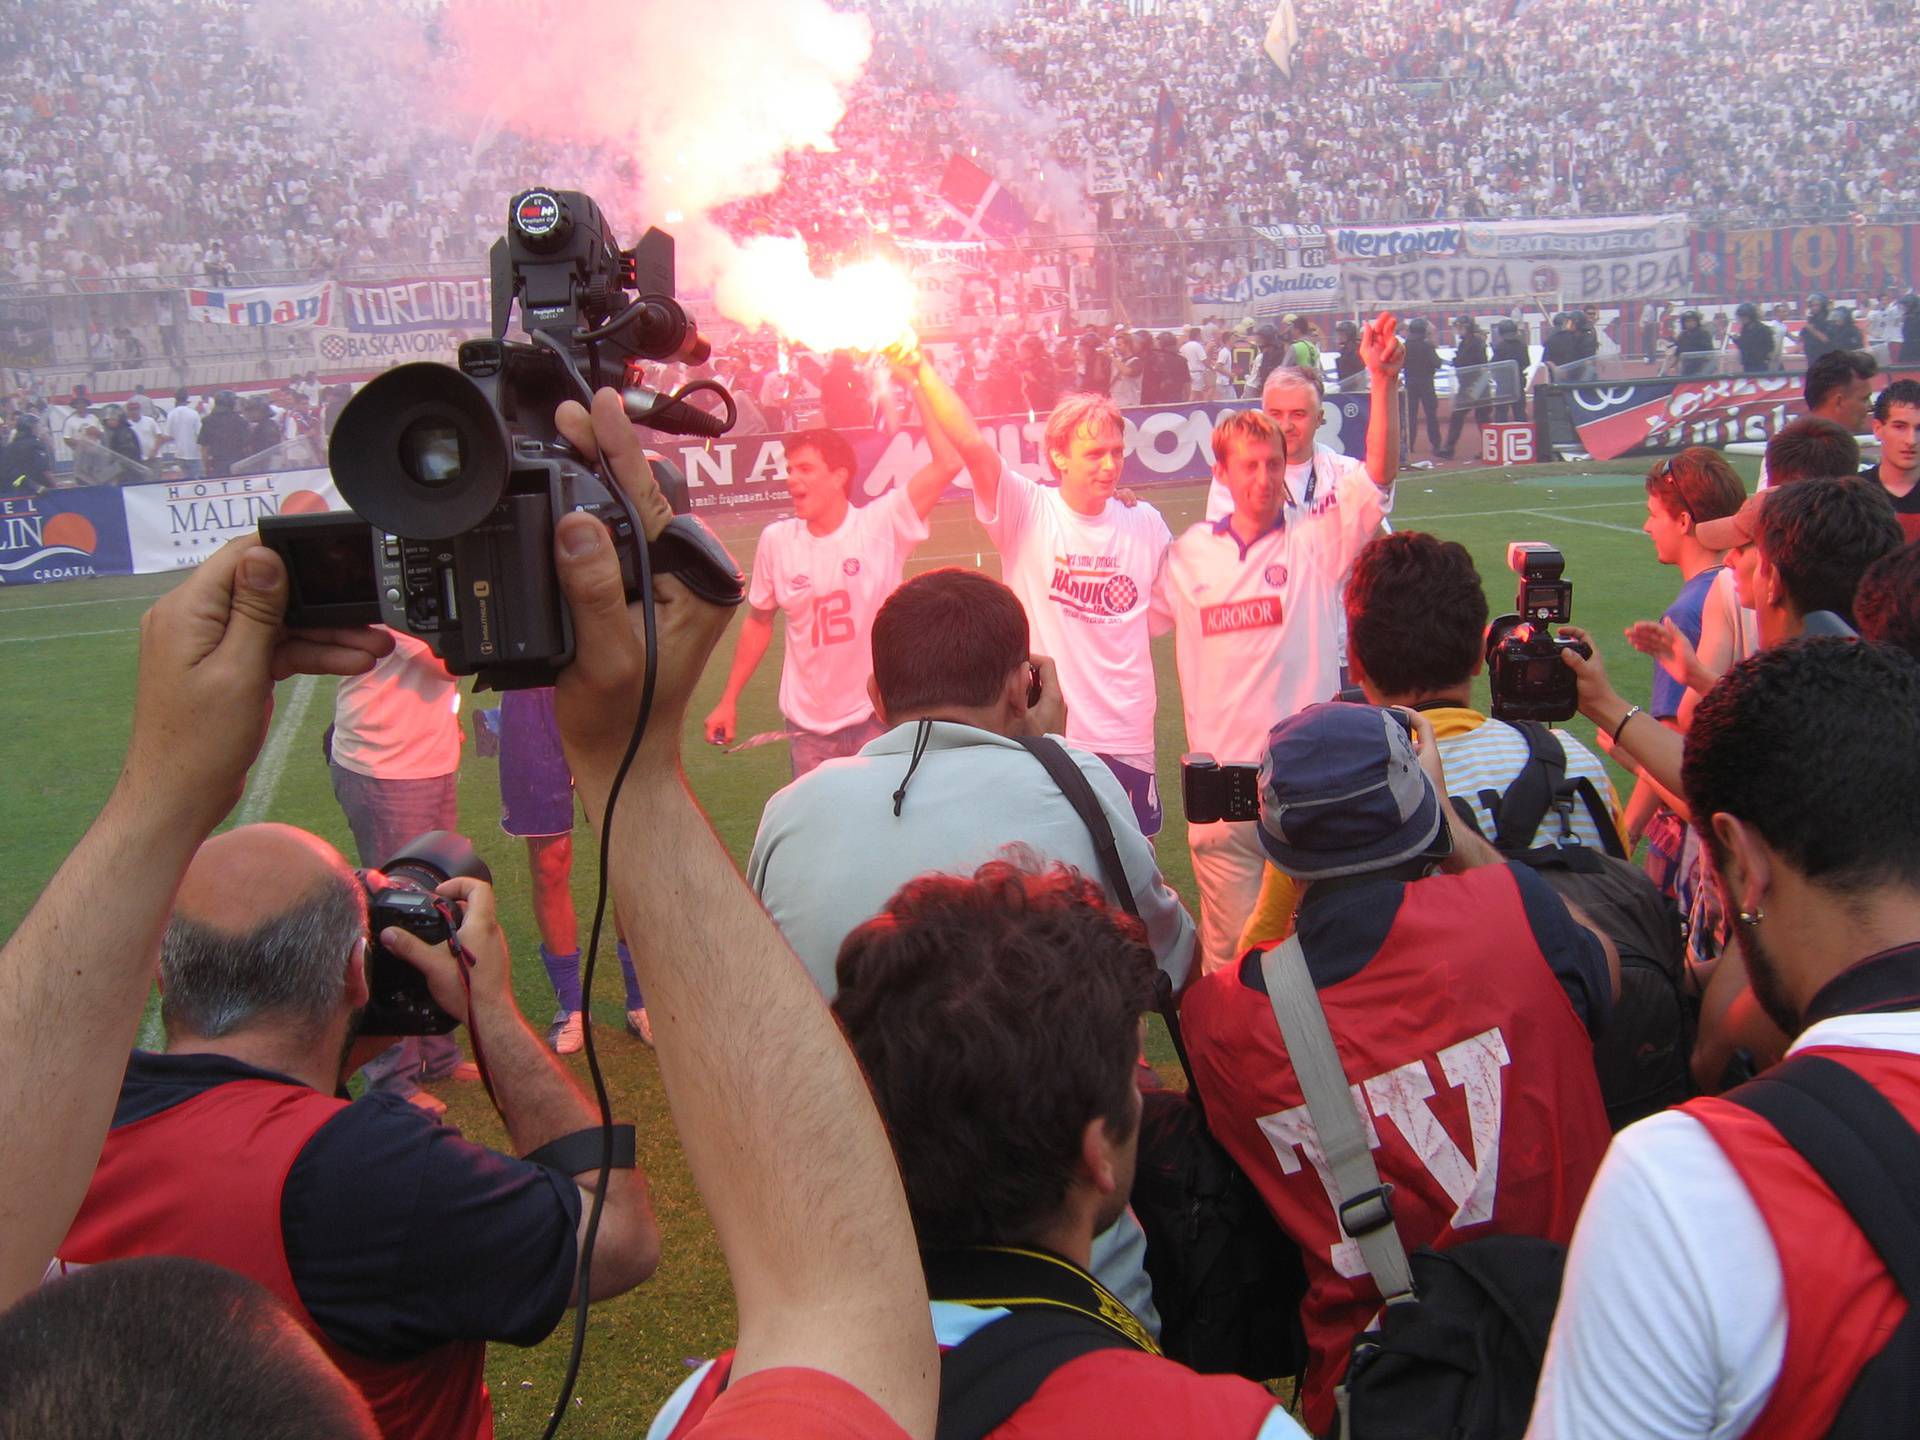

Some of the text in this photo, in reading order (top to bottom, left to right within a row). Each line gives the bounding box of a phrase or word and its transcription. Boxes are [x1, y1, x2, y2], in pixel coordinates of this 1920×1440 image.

[1348, 255, 1687, 301] TORCIDA BRDA
[349, 281, 482, 326] TORCIDA
[169, 476, 275, 499] HOTEL
[167, 494, 280, 535] MALIN
[33, 565, 96, 580] CROATIA
[1207, 600, 1275, 632] AGROKOR
[1256, 1027, 1511, 1279] TV
